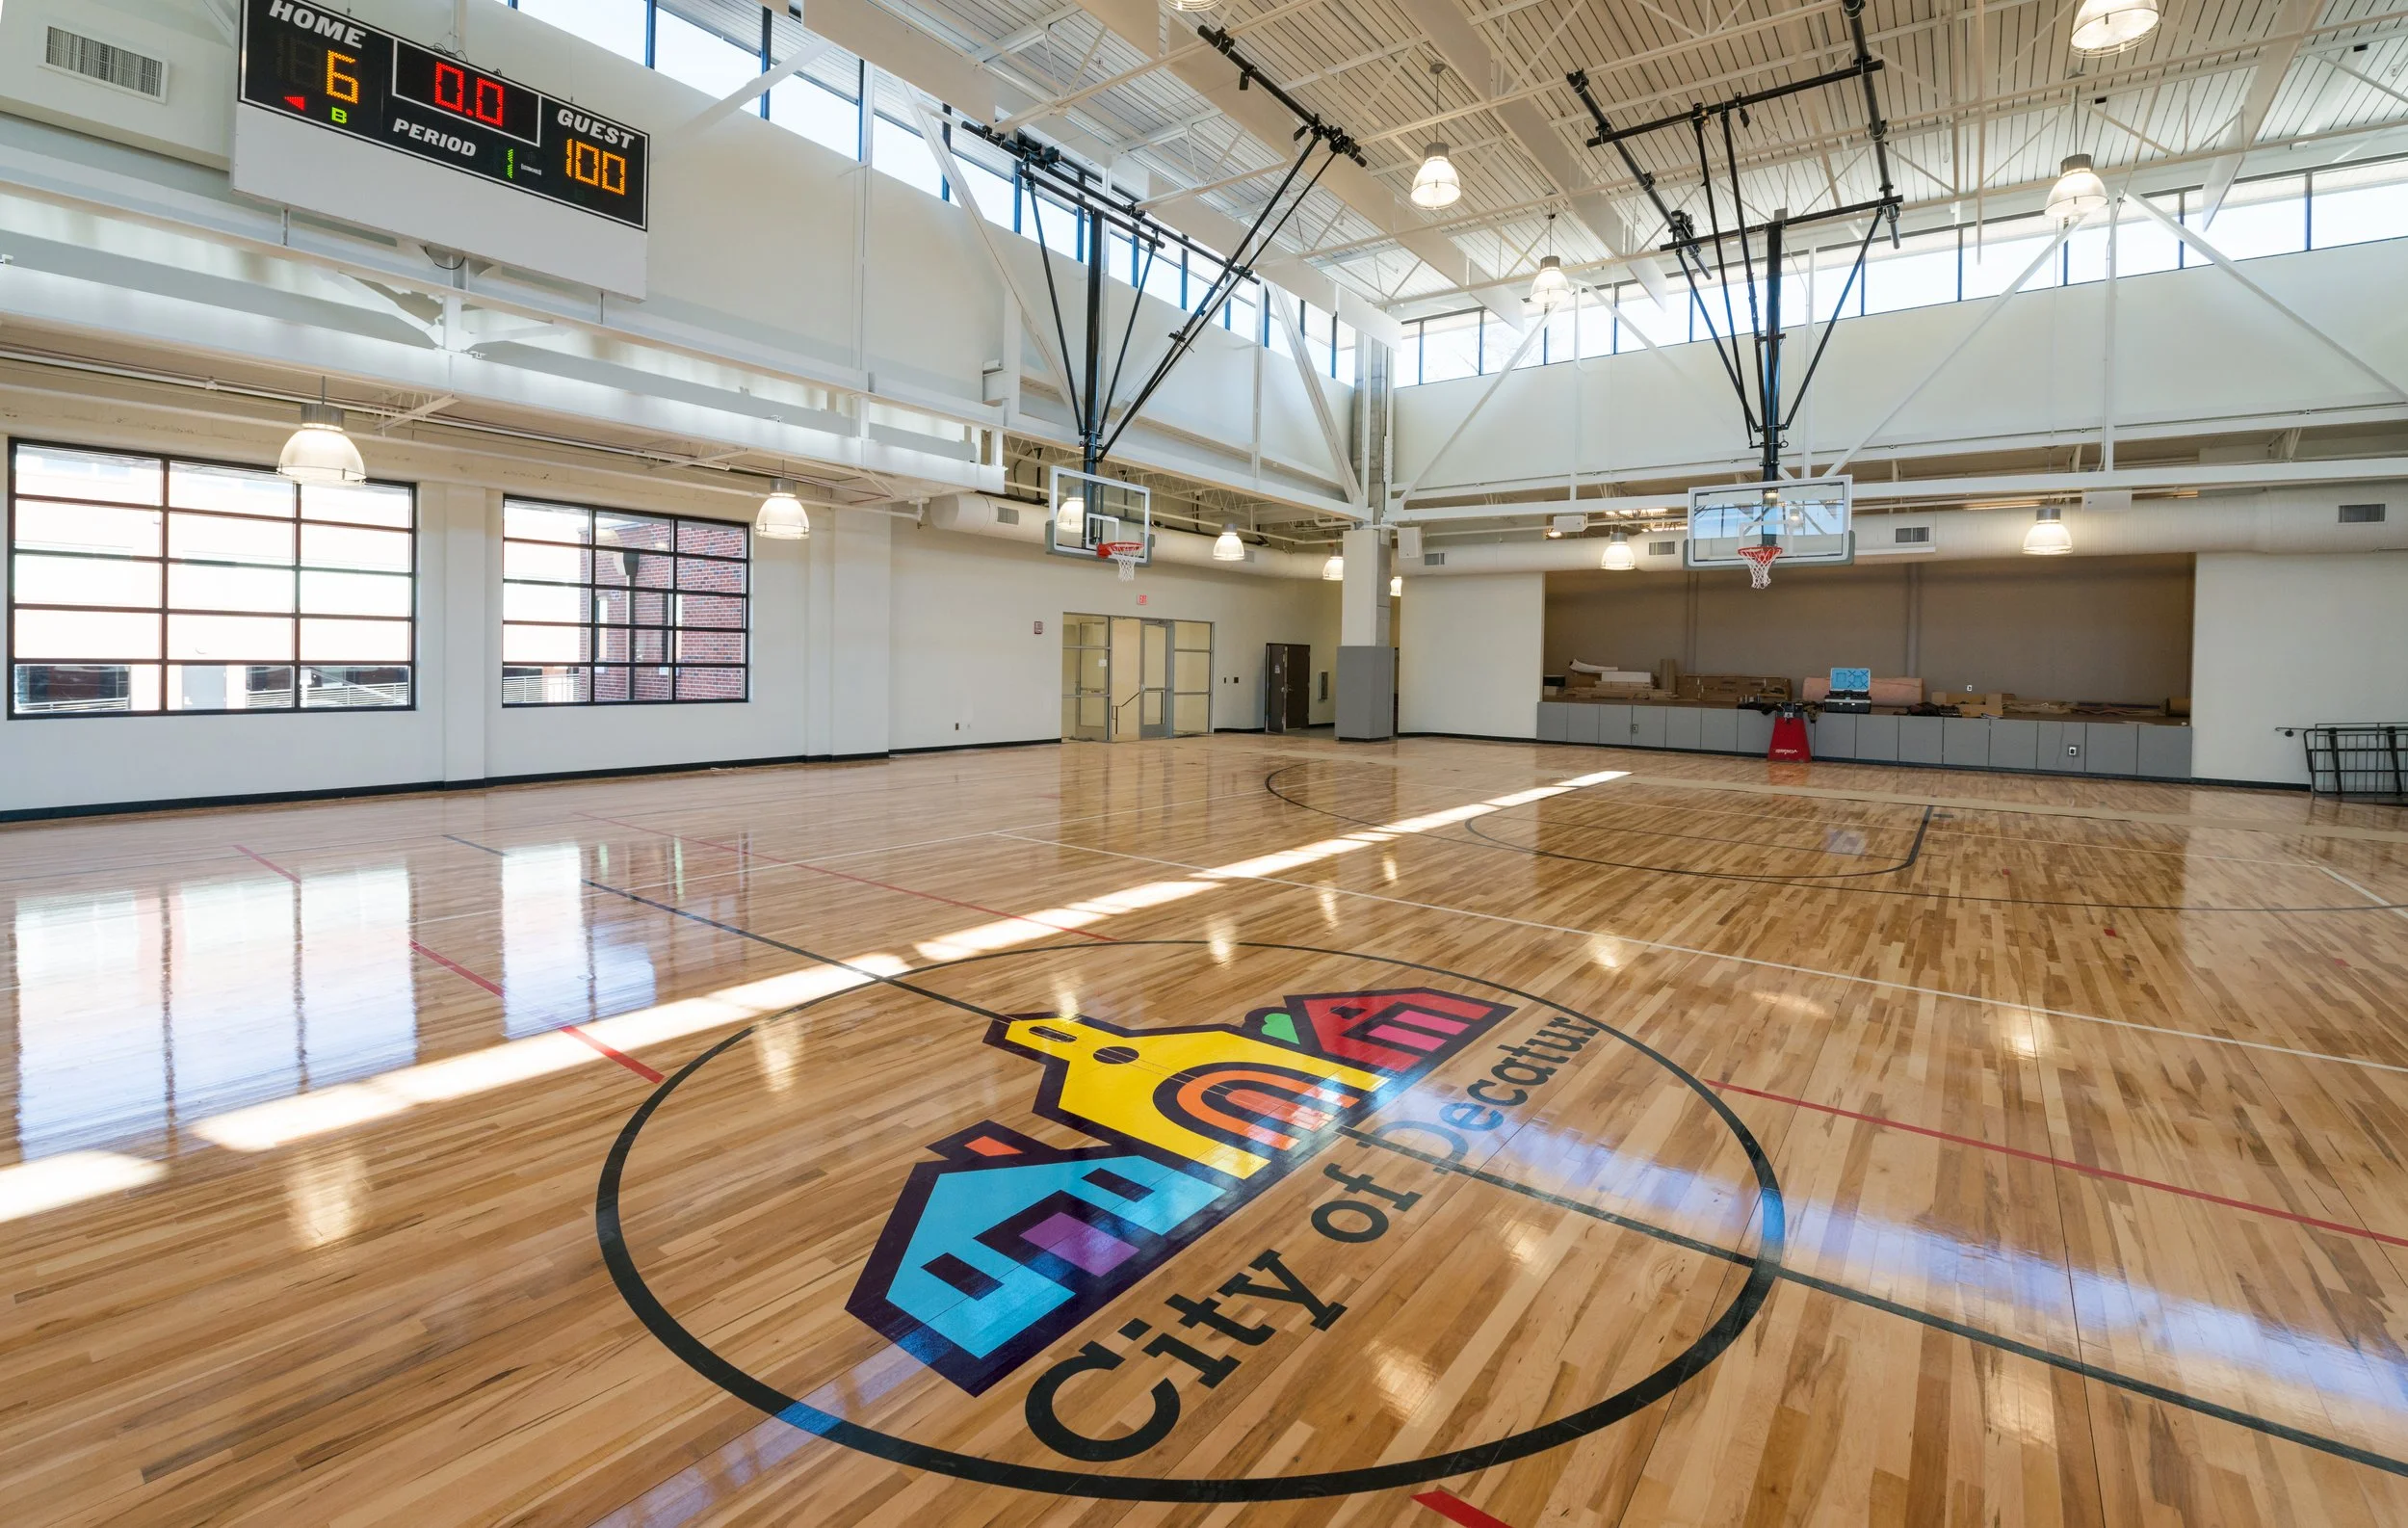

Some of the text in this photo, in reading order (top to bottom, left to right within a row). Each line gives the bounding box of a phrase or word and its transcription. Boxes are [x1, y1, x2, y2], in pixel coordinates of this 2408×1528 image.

[270, 0, 366, 49] HOME
[327, 50, 359, 104] 6
[434, 63, 504, 127] 0.0
[331, 107, 348, 123] B
[394, 119, 477, 157] PERIOD
[558, 109, 635, 149] GUEST
[507, 148, 514, 179] 1
[566, 139, 626, 196] 100
[1024, 1016, 1601, 1462] City of Decatur
